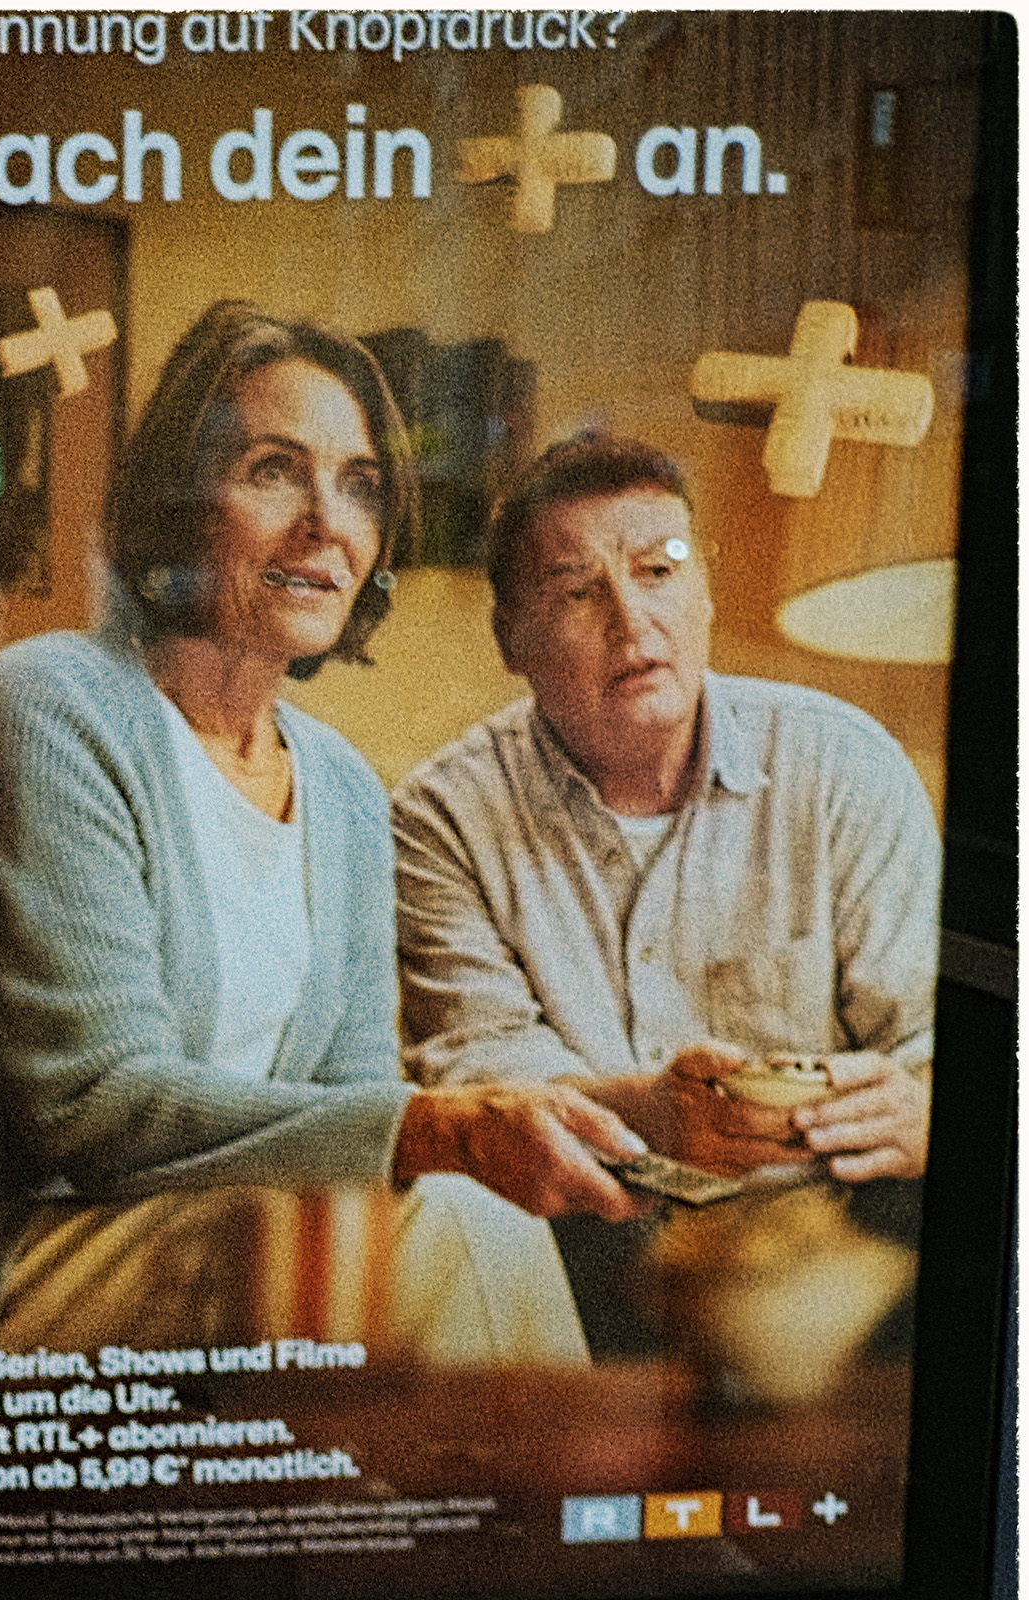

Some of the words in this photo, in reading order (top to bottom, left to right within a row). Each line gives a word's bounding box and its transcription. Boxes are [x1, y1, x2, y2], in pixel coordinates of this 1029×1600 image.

[182, 10, 274, 53] auf
[289, 9, 627, 63] Knopfdruck?
[209, 104, 434, 201] dein
[634, 122, 790, 197] an.
[98, 1344, 207, 1378] Shows
[209, 1342, 272, 1373] und
[275, 1338, 366, 1370] Filme
[3, 1389, 57, 1417] um
[60, 1385, 112, 1415] die
[114, 1384, 181, 1413] Uhr.
[14, 1421, 104, 1454] RTL+
[107, 1416, 295, 1451] abonnieren.
[32, 1459, 78, 1490] ab
[80, 1456, 150, 1492] 5,99
[192, 1447, 360, 1484] monatlich.
